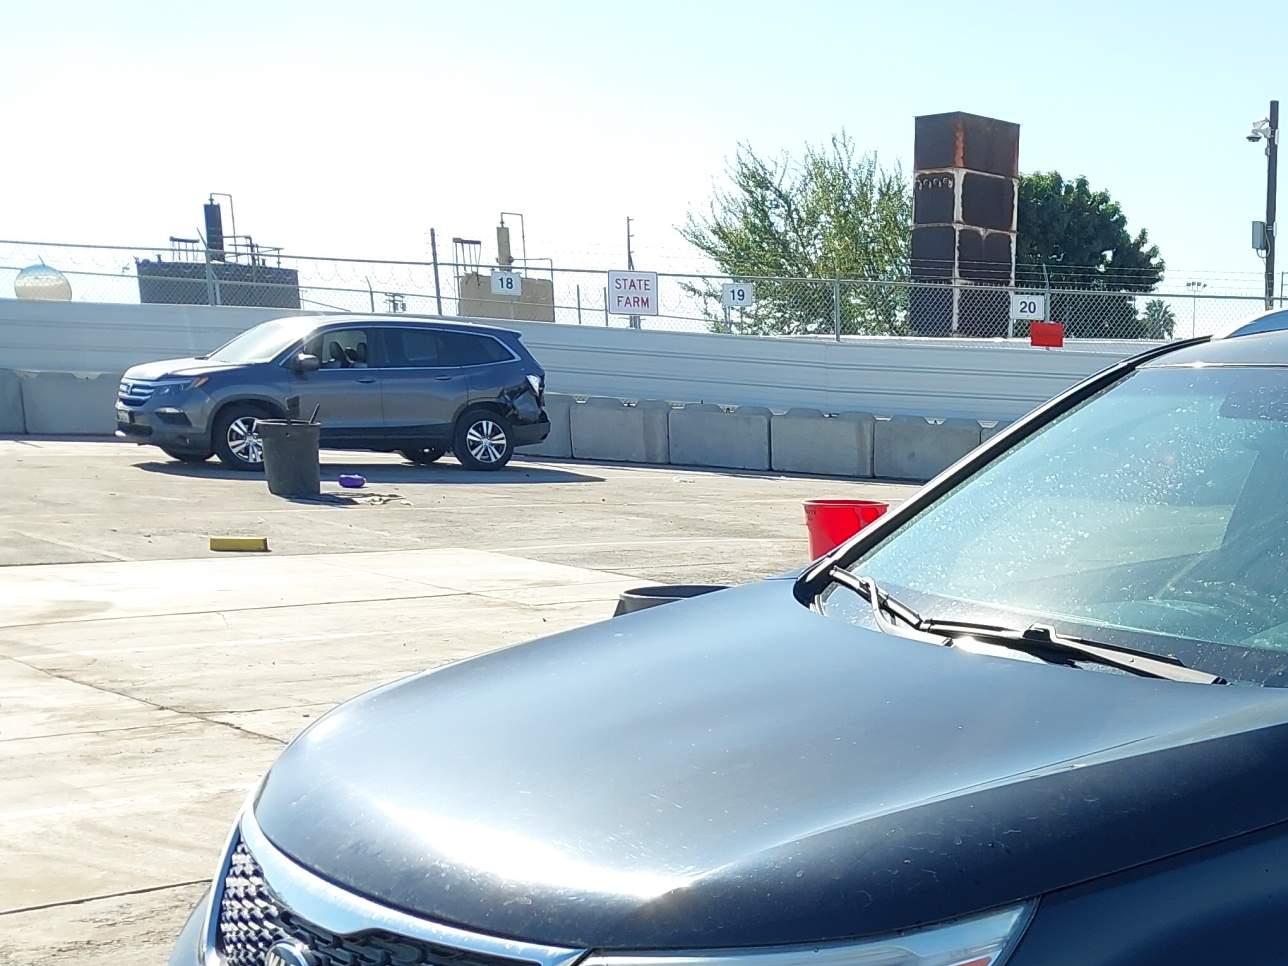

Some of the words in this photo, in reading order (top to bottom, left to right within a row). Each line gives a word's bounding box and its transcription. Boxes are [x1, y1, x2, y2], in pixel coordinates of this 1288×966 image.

[498, 276, 514, 290] 18
[614, 278, 651, 291] STATE
[730, 288, 745, 301] 19
[617, 295, 650, 309] FARM
[1020, 301, 1036, 314] 20
